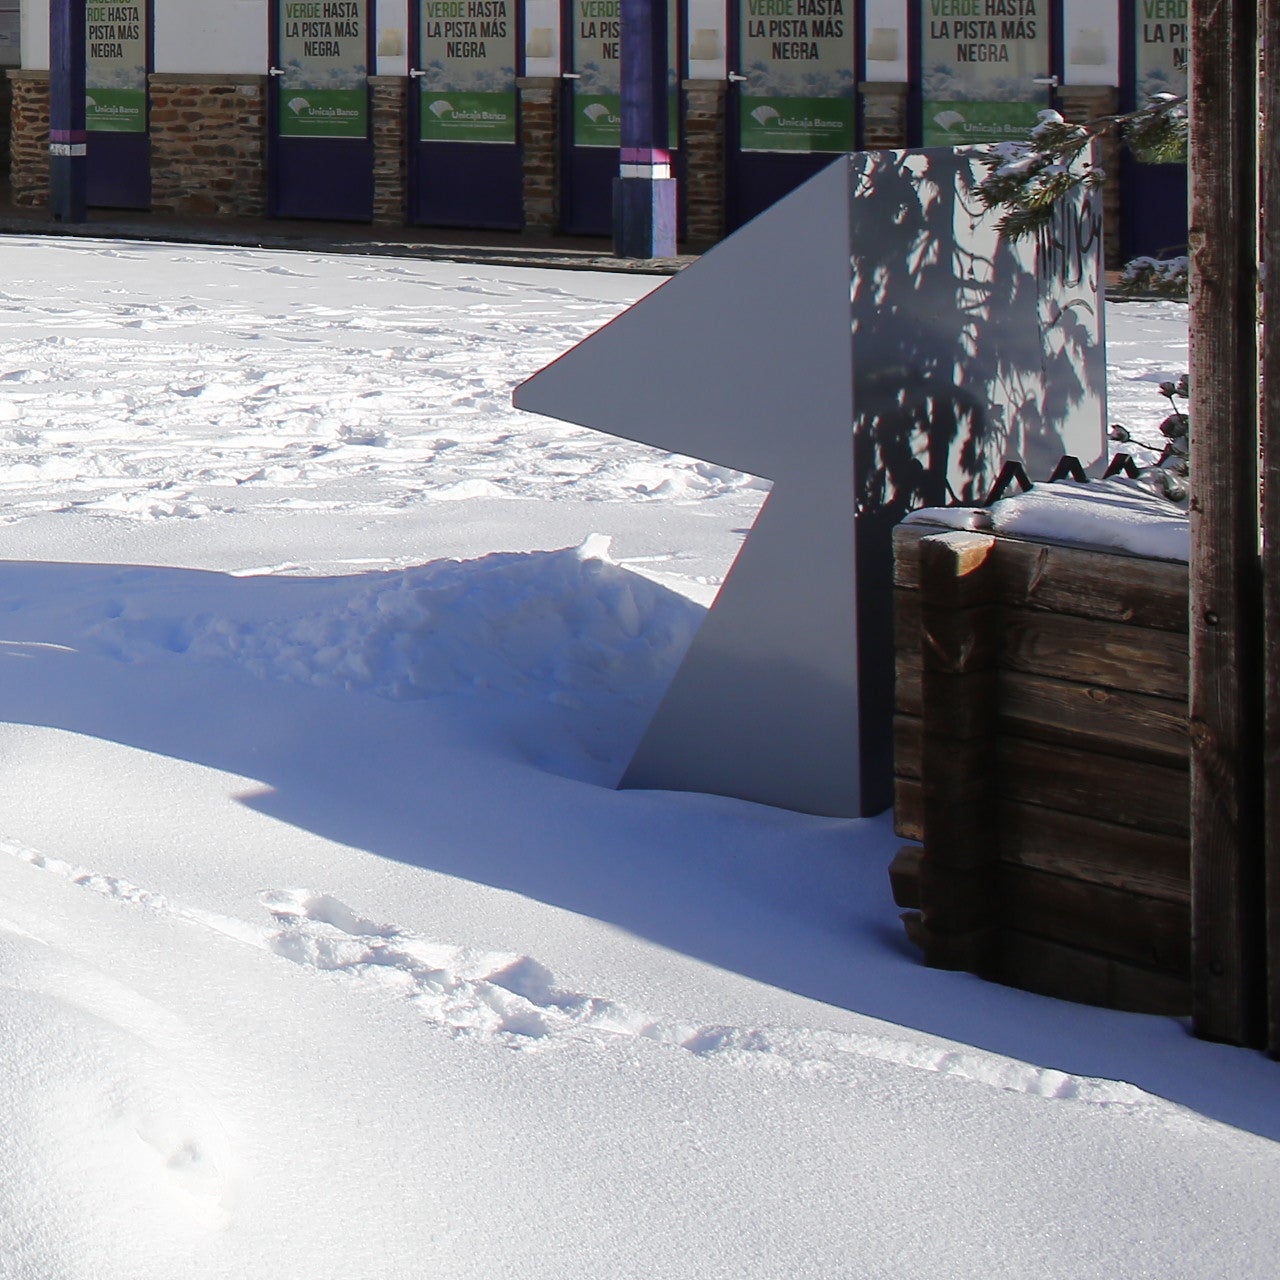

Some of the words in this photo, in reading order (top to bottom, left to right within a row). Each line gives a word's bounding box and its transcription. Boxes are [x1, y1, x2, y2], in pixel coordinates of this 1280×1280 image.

[108, 7, 139, 22] HASTA
[286, 3, 320, 18] VERDE
[323, 2, 359, 18] HASTA
[427, 2, 464, 18] VERDE
[468, 1, 506, 18] HASTA
[1143, 0, 1188, 19] VERD
[89, 25, 116, 40] PISTA
[118, 22, 139, 40] MÁS
[286, 22, 299, 37] LA
[302, 22, 332, 37] PISTA
[335, 19, 359, 37] MÁS
[427, 21, 441, 37] LA
[444, 21, 477, 37] PISTA
[480, 18, 506, 37] MÁS
[581, 21, 596, 38] LA
[600, 21, 620, 39] PIS
[748, 20, 765, 38] LA
[769, 20, 808, 38] PISTA
[812, 17, 843, 38] MÁS
[930, 21, 949, 39] LA
[954, 21, 996, 39] PISTA
[1001, 17, 1036, 39] MÁS
[1143, 24, 1165, 43] LA
[91, 43, 123, 58] NEGRA
[304, 41, 340, 57] NEGRA
[447, 41, 486, 58] NEGRA
[772, 41, 819, 60] NEGRA
[957, 43, 1009, 62] NEGRA
[308, 107, 336, 118] Unicaja
[337, 108, 359, 116] Banco
[451, 110, 481, 121] Unicaja
[482, 111, 506, 120] Banco
[778, 117, 813, 128] Unicaja
[814, 118, 843, 127] Banco
[963, 122, 1002, 134] Unicaja
[1004, 124, 1032, 133] Banc
